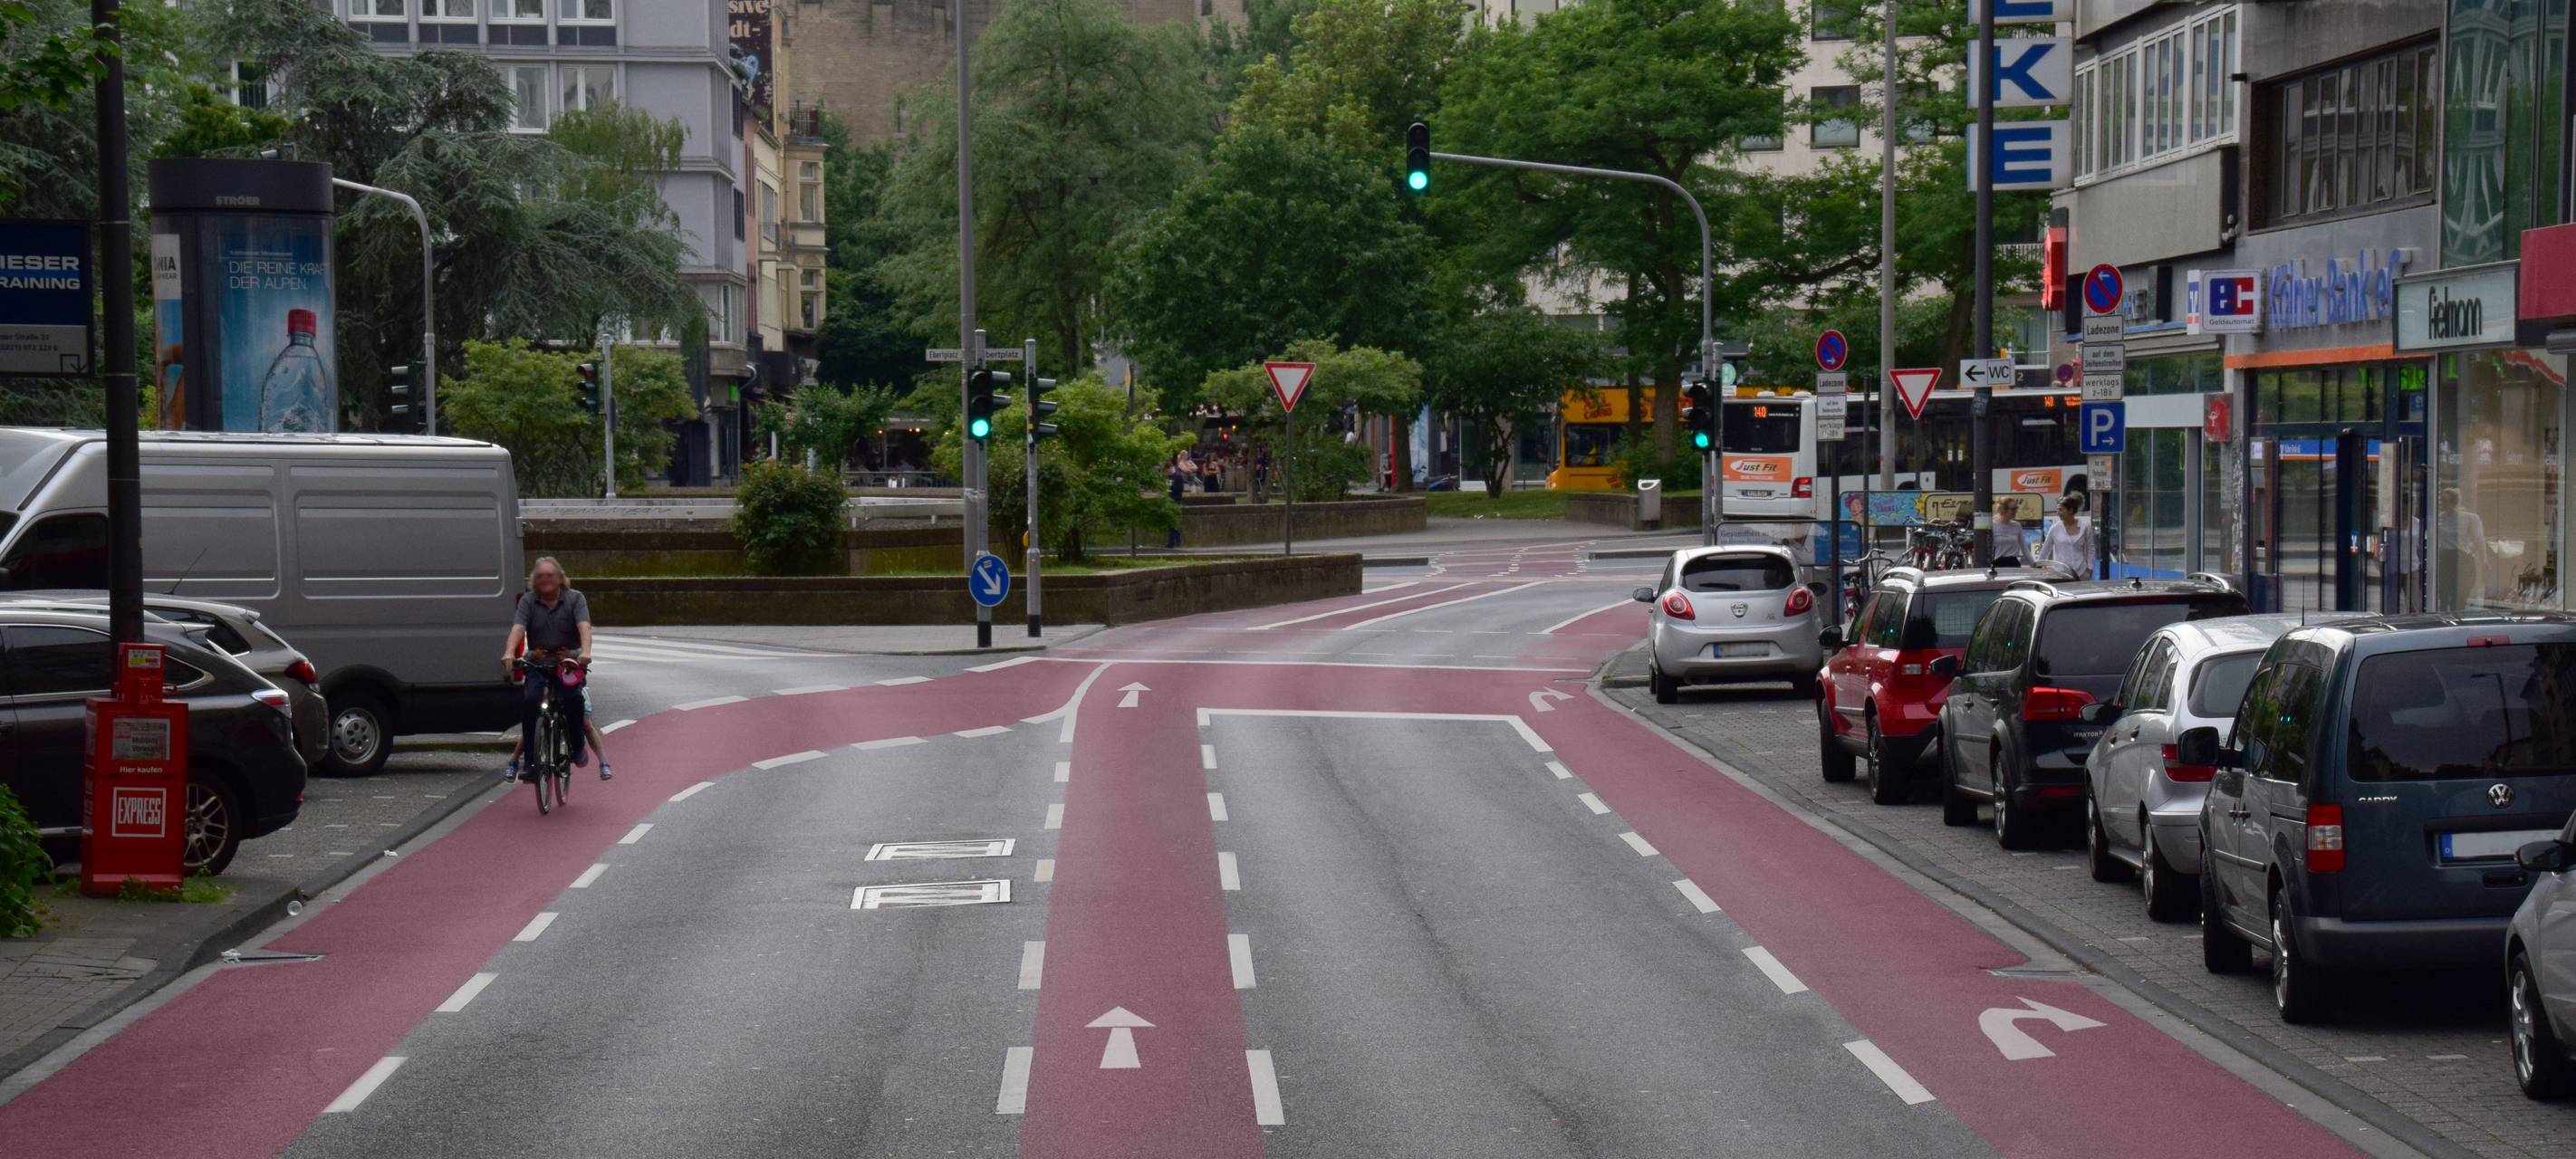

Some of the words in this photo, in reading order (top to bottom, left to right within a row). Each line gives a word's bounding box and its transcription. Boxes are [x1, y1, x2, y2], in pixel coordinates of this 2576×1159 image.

[216, 196, 261, 206] STRÖER
[229, 261, 254, 273] DIE
[257, 262, 296, 274] REINE
[230, 276, 260, 289] DER
[2268, 259, 2322, 330] Kölner
[2327, 248, 2371, 324] Bank
[2086, 324, 2120, 335] Ladezone
[985, 350, 1019, 359] bertplatz
[1989, 365, 2010, 378] WC
[1819, 378, 1844, 388] Ladezone
[2085, 378, 2119, 388] werktags
[2091, 408, 2115, 446] P
[1735, 462, 1761, 471] Just
[1763, 463, 1777, 472] Fit
[2021, 475, 2040, 484] Just
[2041, 475, 2052, 484] Fit
[117, 797, 161, 824] EXPRESS
